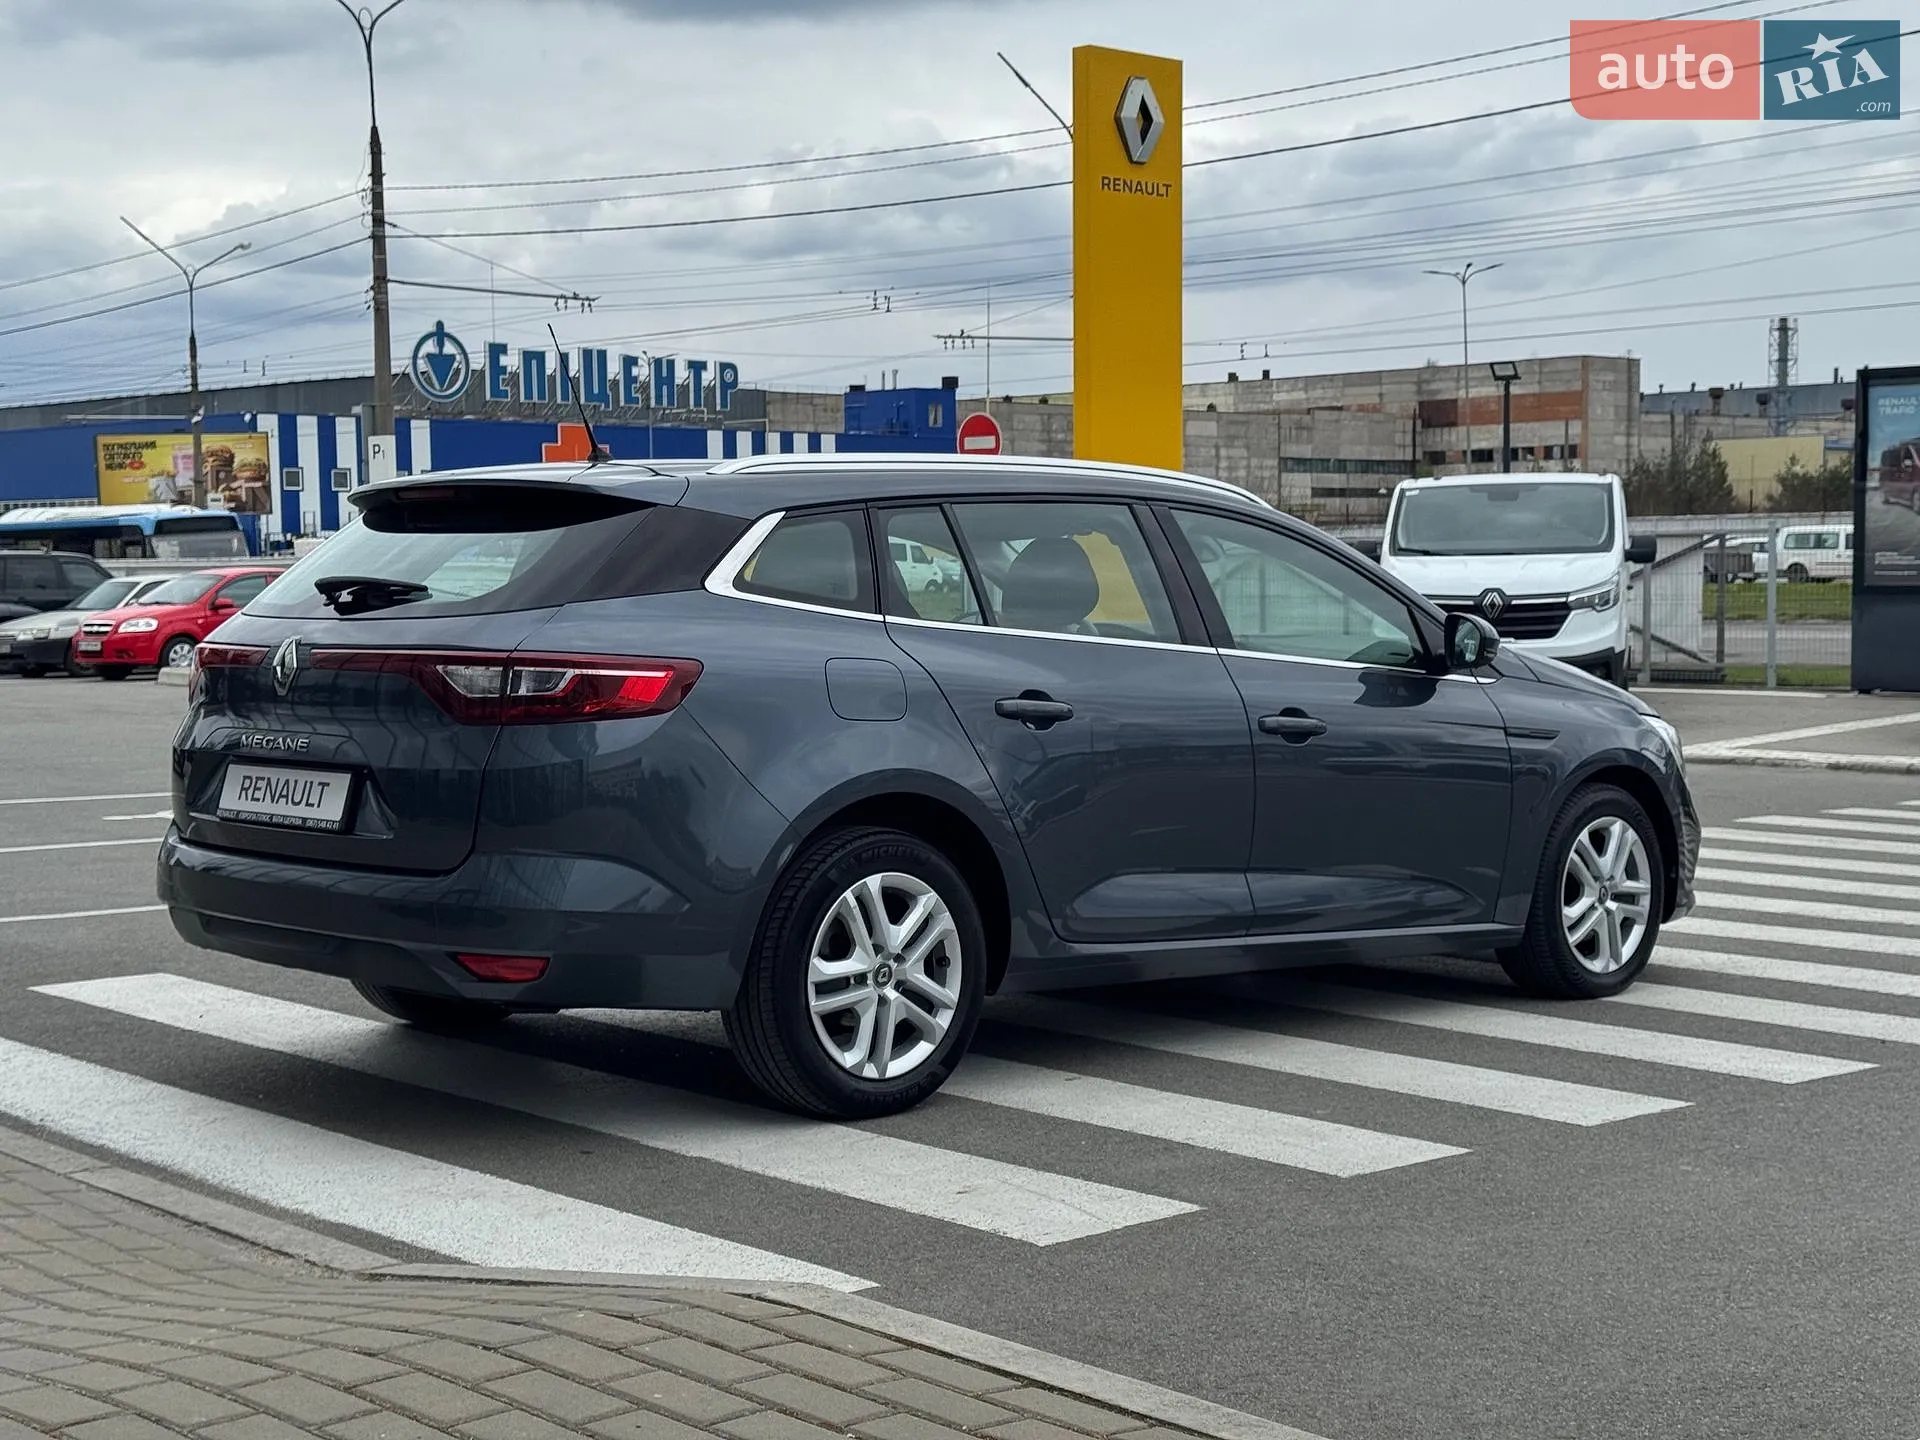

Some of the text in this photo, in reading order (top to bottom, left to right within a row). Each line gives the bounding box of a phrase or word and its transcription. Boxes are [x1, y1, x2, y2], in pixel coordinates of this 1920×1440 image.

[1101, 176, 1172, 198] RENAULT
[484, 340, 739, 411] ЕПІЦЕНТР
[240, 734, 311, 752] MEGANE
[238, 775, 330, 809] RENAULT
